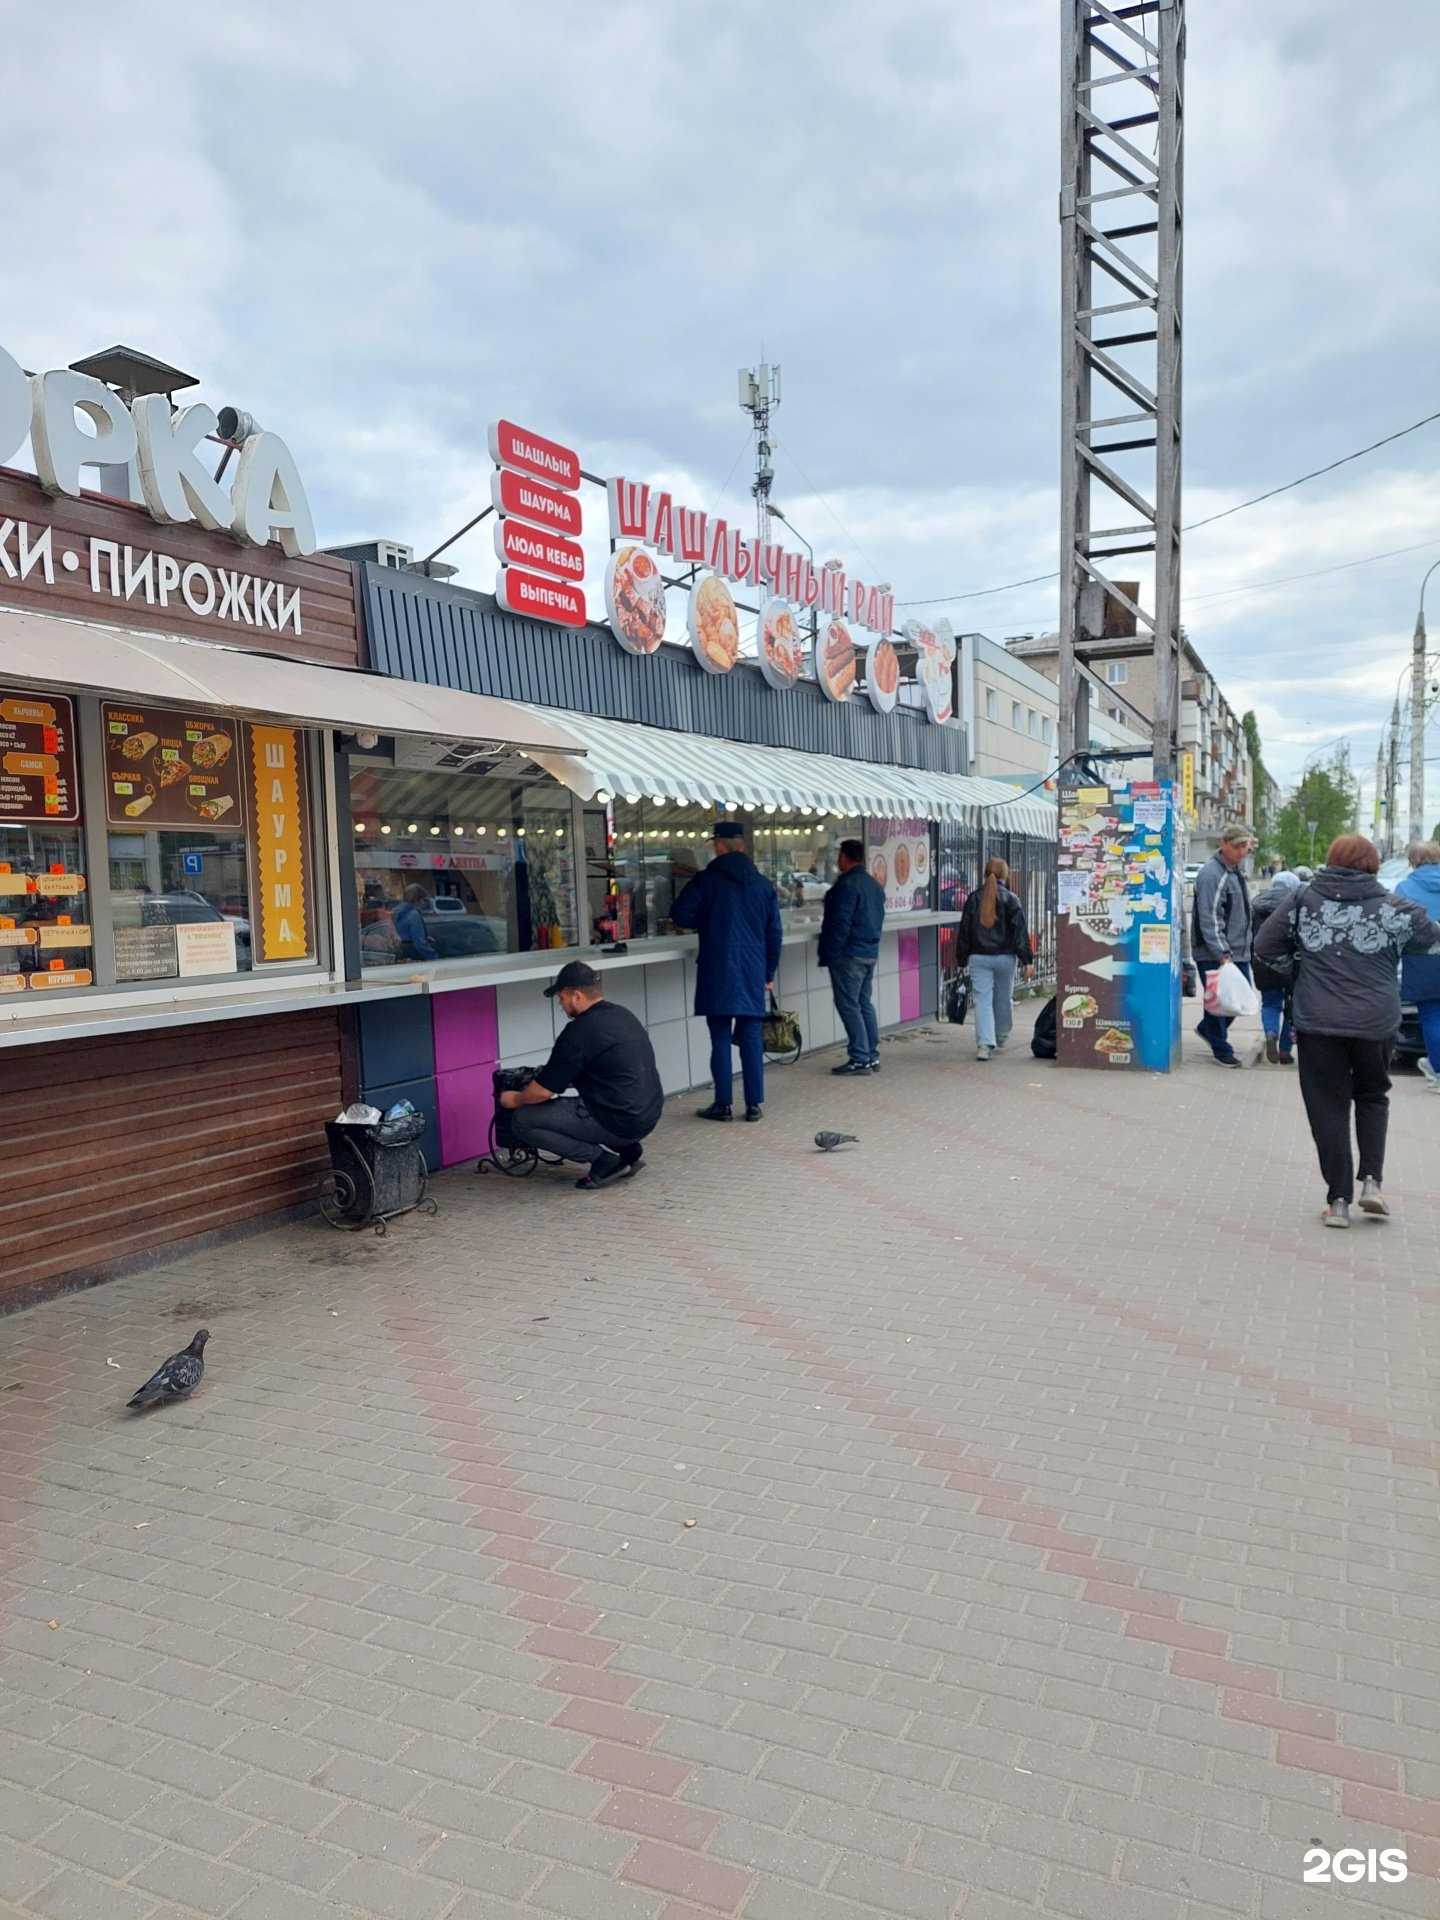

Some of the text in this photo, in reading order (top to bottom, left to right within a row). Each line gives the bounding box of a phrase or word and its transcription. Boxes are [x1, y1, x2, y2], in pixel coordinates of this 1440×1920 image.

[511, 438, 572, 479] ШАШЛЫК
[519, 488, 572, 523] ШАУРМА
[506, 533, 583, 572] ЛЮЛЯ КЕБАБ
[608, 475, 895, 637] ШАШЛЫЧНЫЙ РАЙ
[89, 536, 302, 636] ПИРОЖКИ
[519, 581, 579, 614] ВЫПЕЧКА
[265, 743, 293, 942] ШАУРМА
